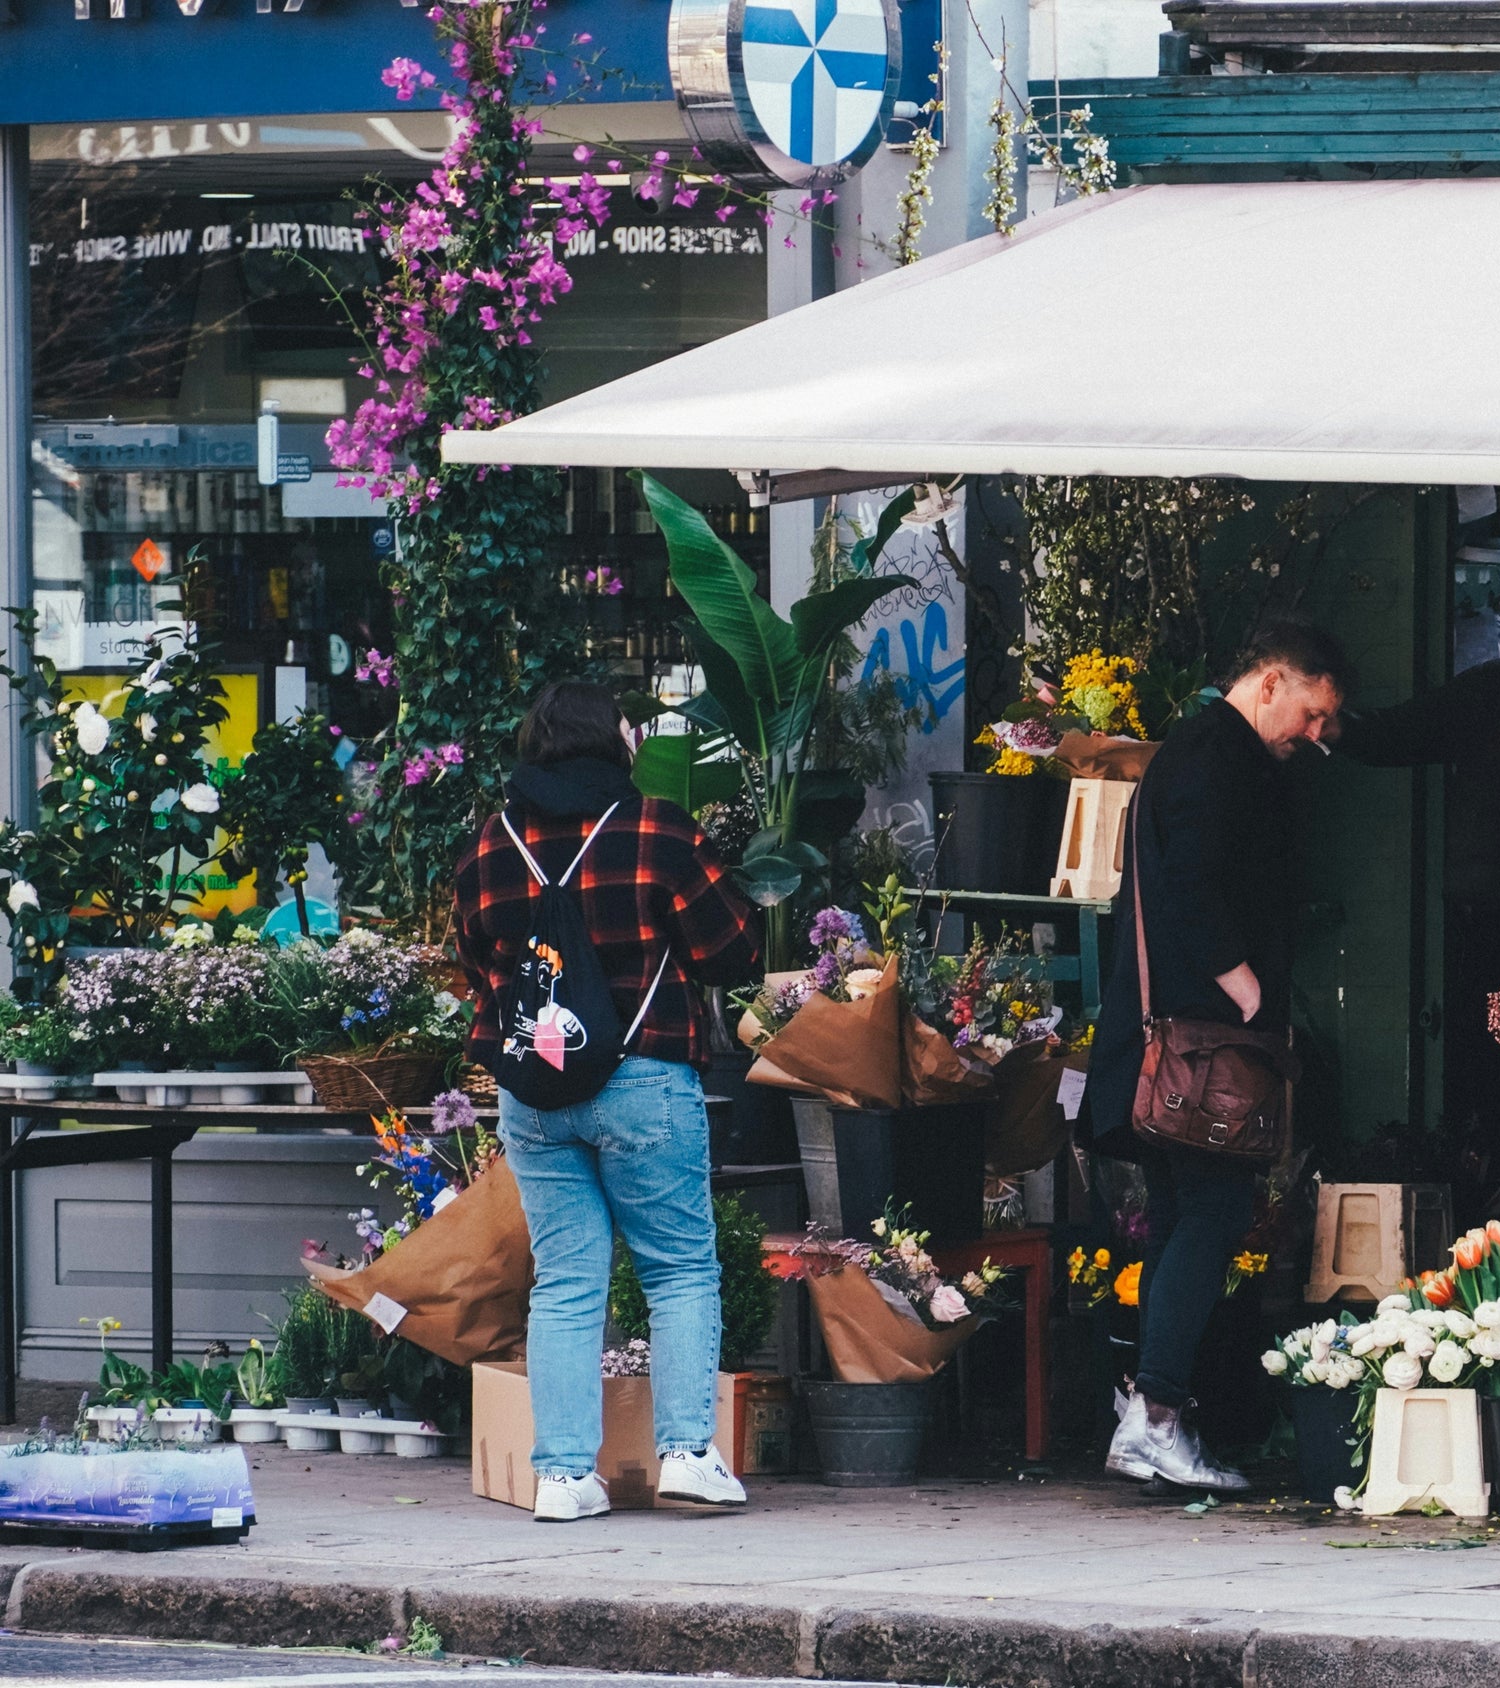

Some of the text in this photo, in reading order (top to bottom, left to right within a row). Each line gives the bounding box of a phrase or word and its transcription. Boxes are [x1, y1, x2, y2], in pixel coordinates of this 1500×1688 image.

[40, 437, 252, 466] ermalogica
[37, 598, 159, 631] NVIRON
[543, 1474, 567, 1484] FILA
[714, 1463, 729, 1479] FILA
